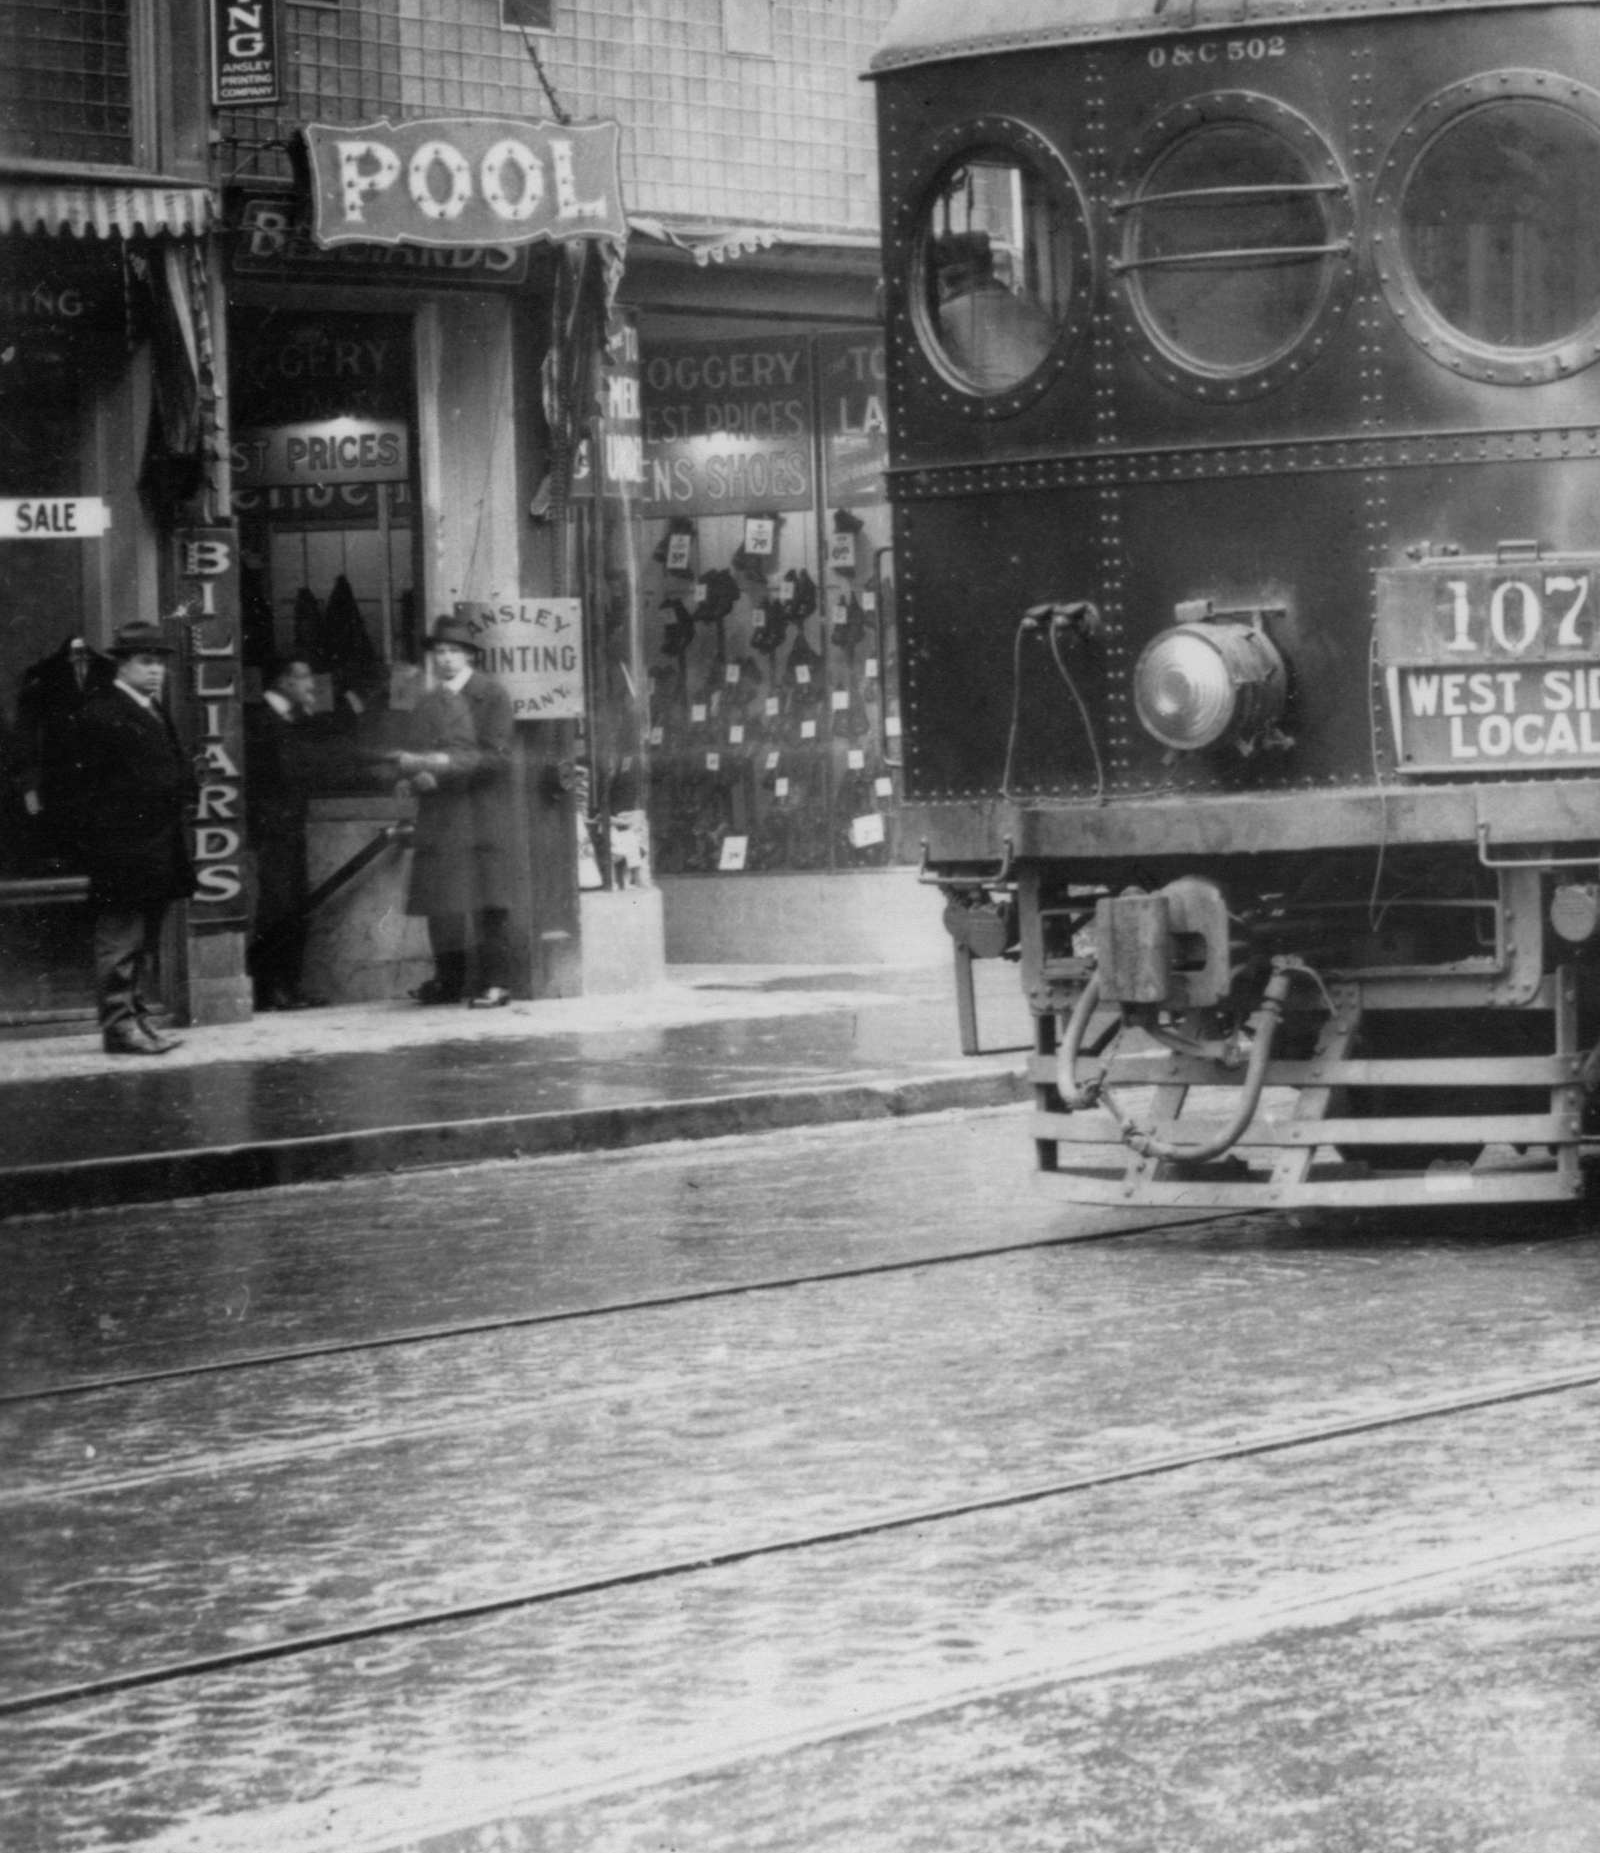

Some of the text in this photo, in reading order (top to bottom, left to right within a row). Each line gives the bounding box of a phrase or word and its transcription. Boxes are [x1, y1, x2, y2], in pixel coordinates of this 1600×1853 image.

[1227, 35, 1286, 62] 502
[220, 73, 273, 87] PRINTING
[221, 60, 272, 73] ANSLEY
[220, 86, 273, 99] COMPANY
[334, 137, 608, 223] POOL
[642, 350, 801, 391] OGGERY
[287, 431, 400, 472] PRICES
[706, 451, 806, 498] SHOES
[17, 503, 77, 532] SALE
[466, 604, 572, 639] ANSLEY
[1446, 575, 1589, 653] 107
[472, 645, 577, 674] RINTING
[513, 685, 573, 714] PANY
[1407, 671, 1522, 717] WEST
[185, 539, 242, 903] BILLIARDS
